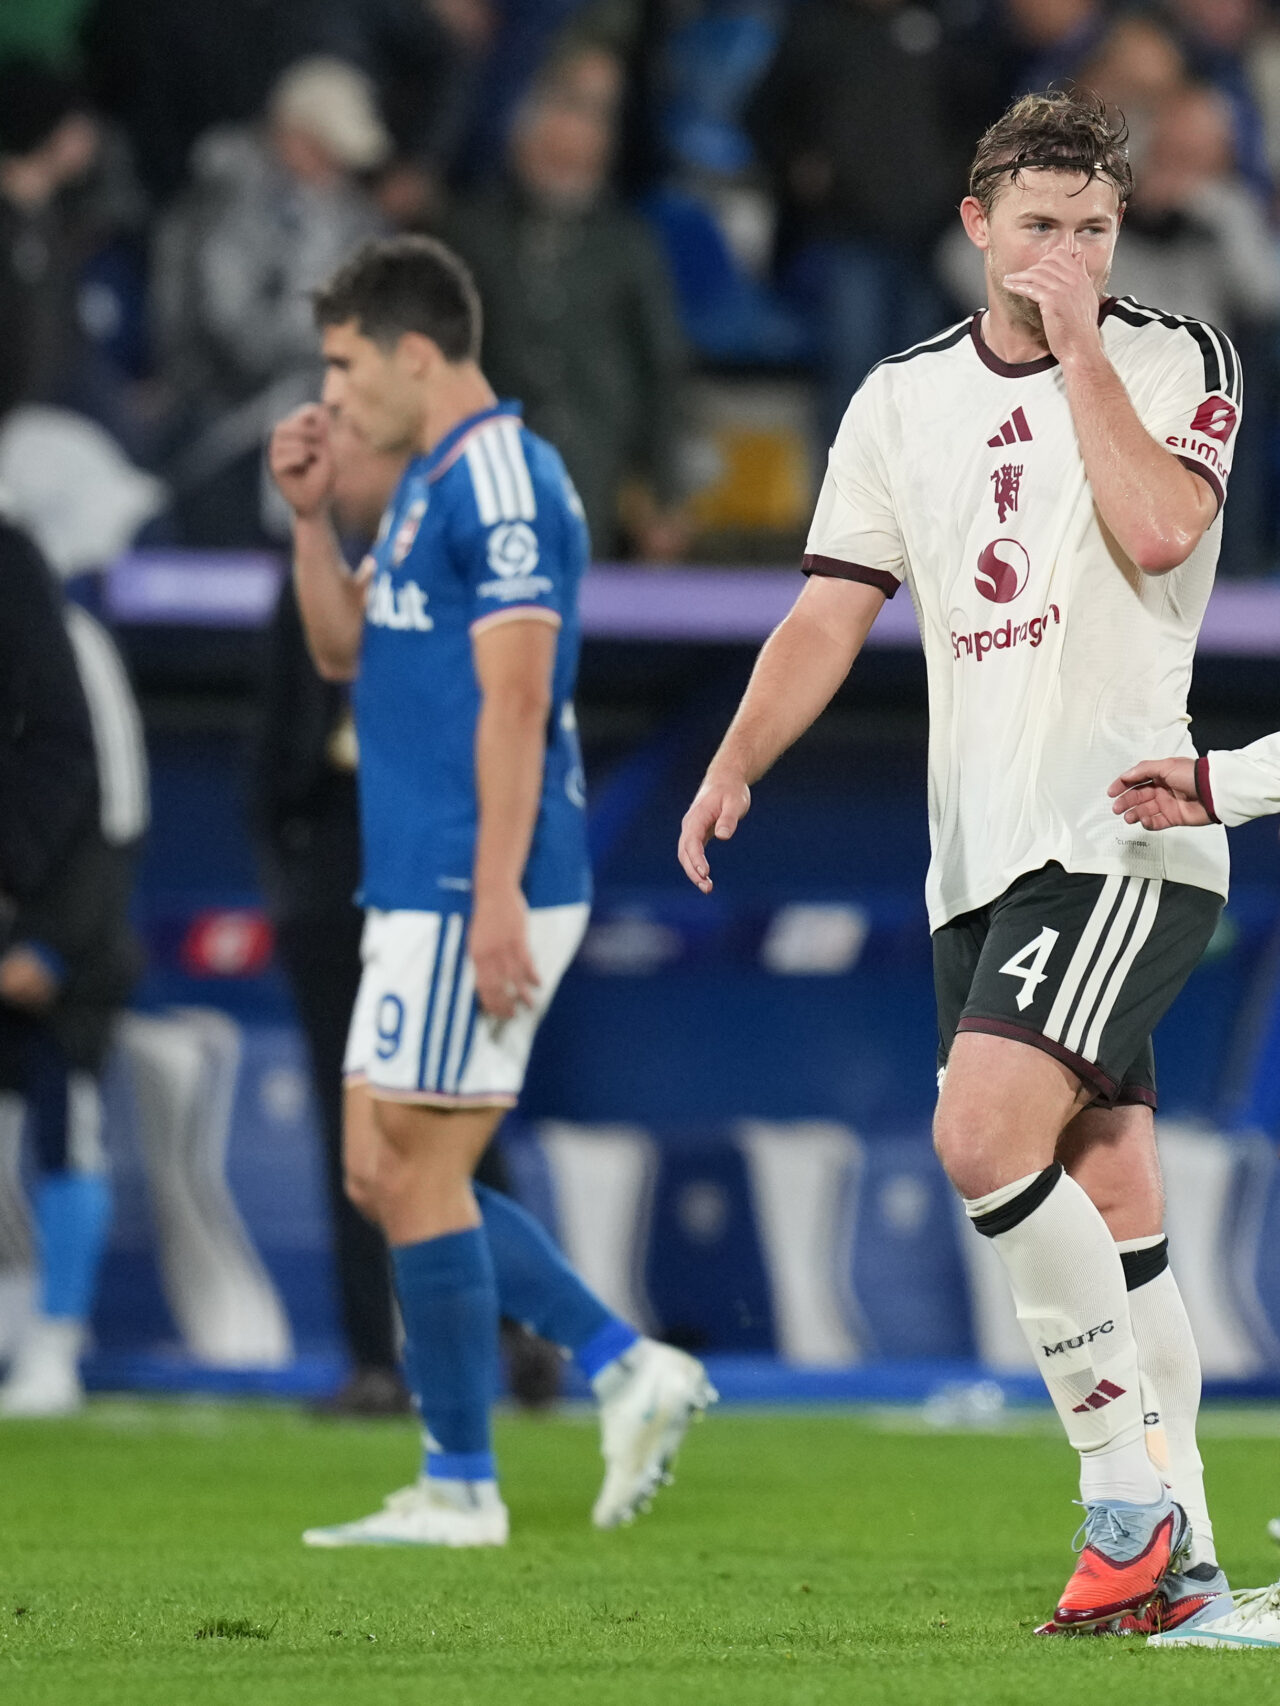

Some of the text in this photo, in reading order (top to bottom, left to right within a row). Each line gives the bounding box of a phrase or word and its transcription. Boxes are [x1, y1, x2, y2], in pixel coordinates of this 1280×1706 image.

[1165, 435, 1229, 479] sum
[998, 926, 1060, 1011] 4
[376, 993, 405, 1061] 9
[1042, 1320, 1114, 1357] MUFC
